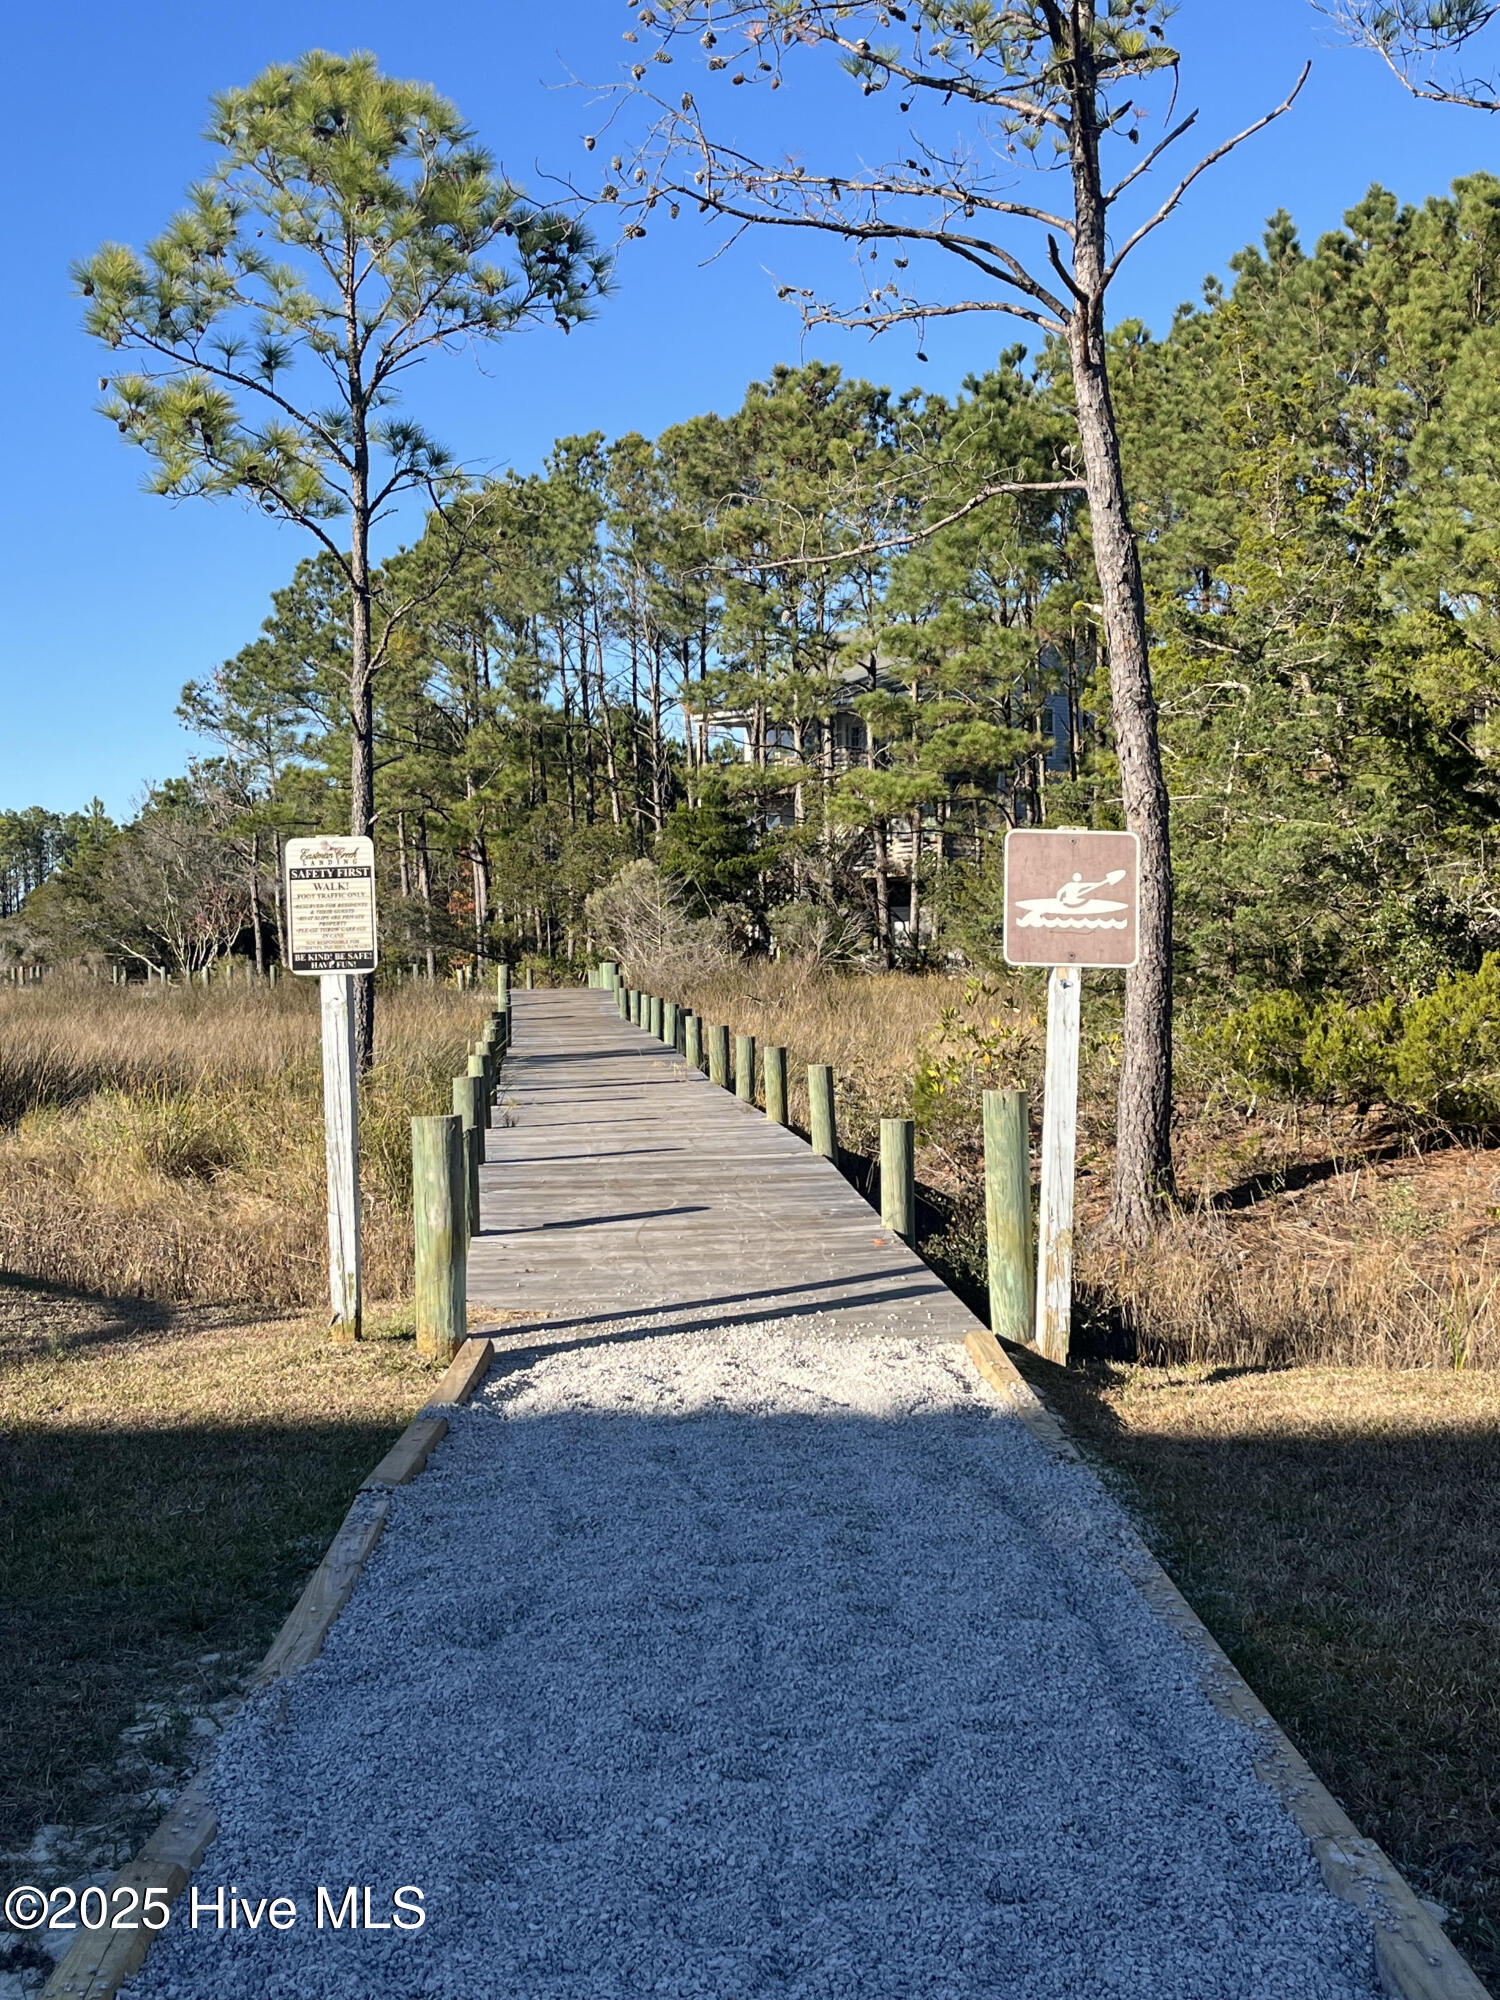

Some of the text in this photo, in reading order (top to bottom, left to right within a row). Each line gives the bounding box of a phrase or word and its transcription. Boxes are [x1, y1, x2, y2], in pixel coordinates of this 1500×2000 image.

[291, 868, 370, 878] SAFETY FIRST
[313, 882, 349, 891] WALK!
[294, 954, 306, 962] BE
[348, 952, 372, 960] SAFE!
